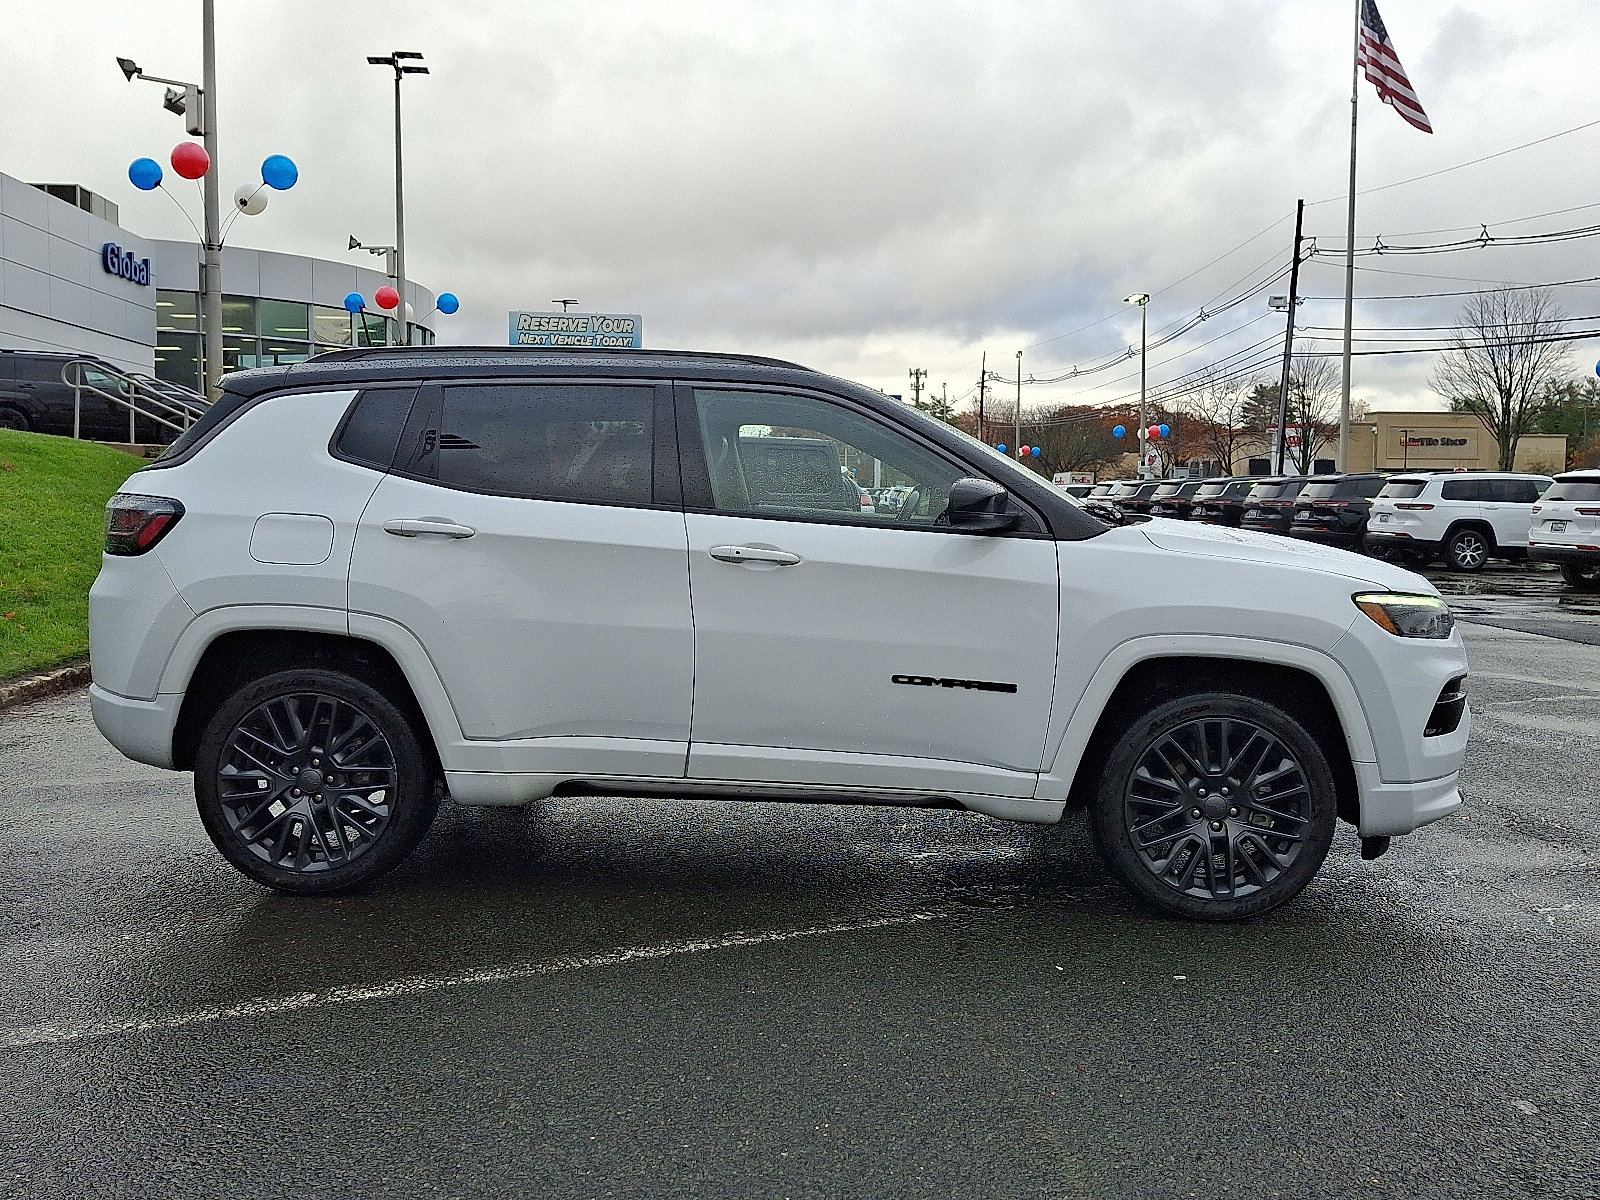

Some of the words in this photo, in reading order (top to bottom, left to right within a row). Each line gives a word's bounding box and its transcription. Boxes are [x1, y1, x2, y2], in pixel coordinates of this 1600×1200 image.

[102, 243, 150, 287] Global
[517, 314, 588, 331] RESERVE
[591, 316, 634, 333] YOUR
[519, 333, 549, 345] NEXT
[549, 333, 594, 346] VEHICLE
[595, 335, 633, 347] TODAY!
